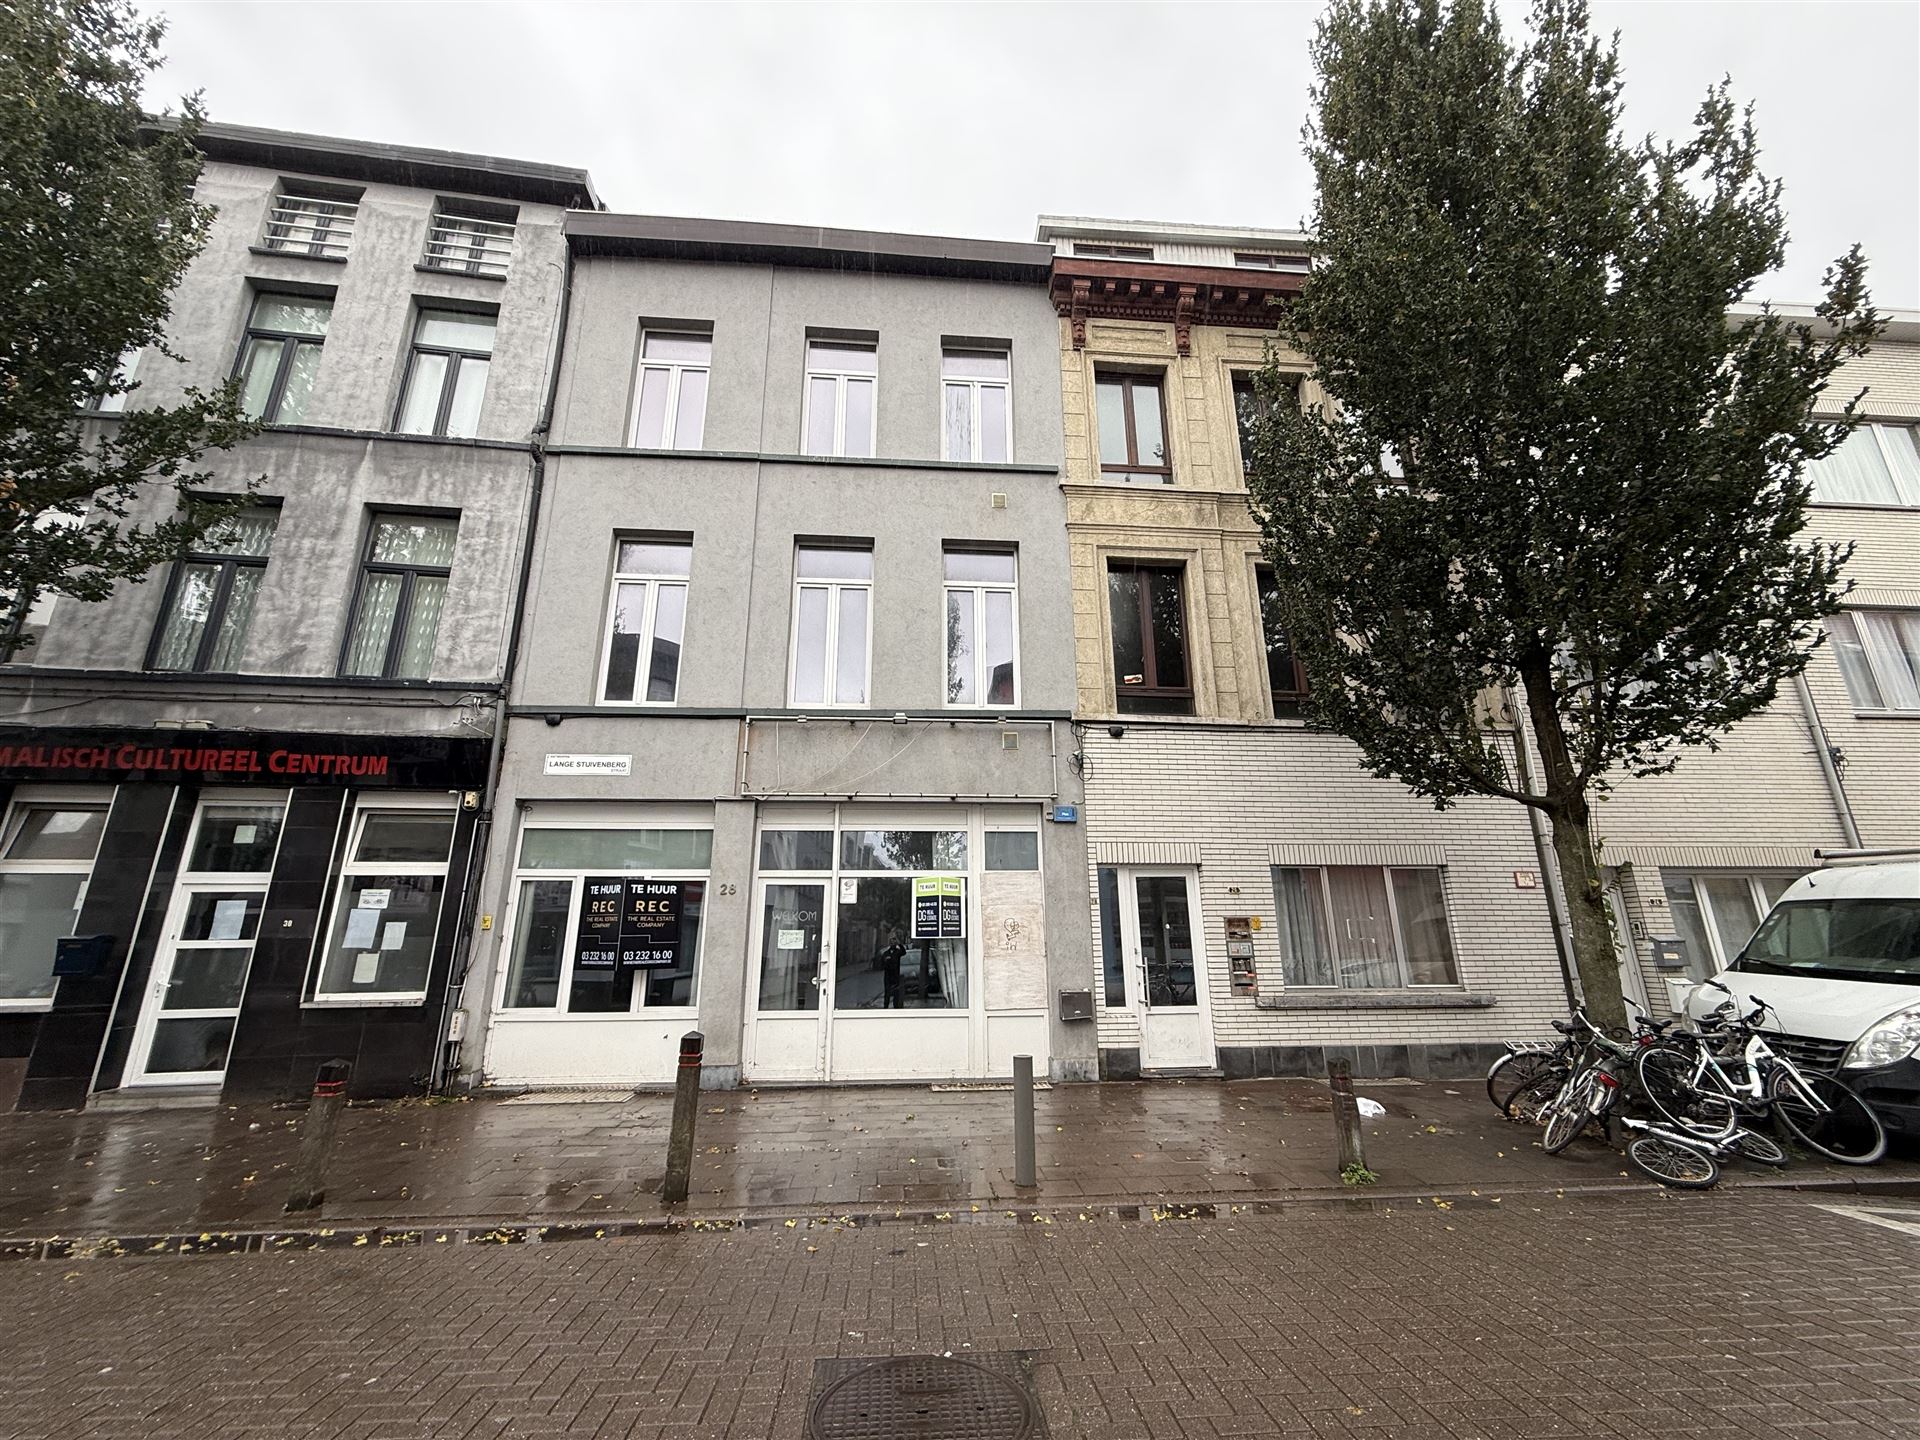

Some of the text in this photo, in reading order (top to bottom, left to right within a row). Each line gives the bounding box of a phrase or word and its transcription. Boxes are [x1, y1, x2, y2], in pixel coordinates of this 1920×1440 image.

[115, 743, 262, 772] CULTUREEL
[268, 749, 389, 776] CENTRUM
[590, 884, 621, 895] TE HUUR
[631, 884, 677, 894] TE HUUR
[591, 900, 615, 912] REC
[635, 900, 670, 912] REC
[772, 910, 817, 922] WELKOM
[581, 951, 615, 960] 03 232 16 00
[623, 950, 673, 960] 03 232 16 00
